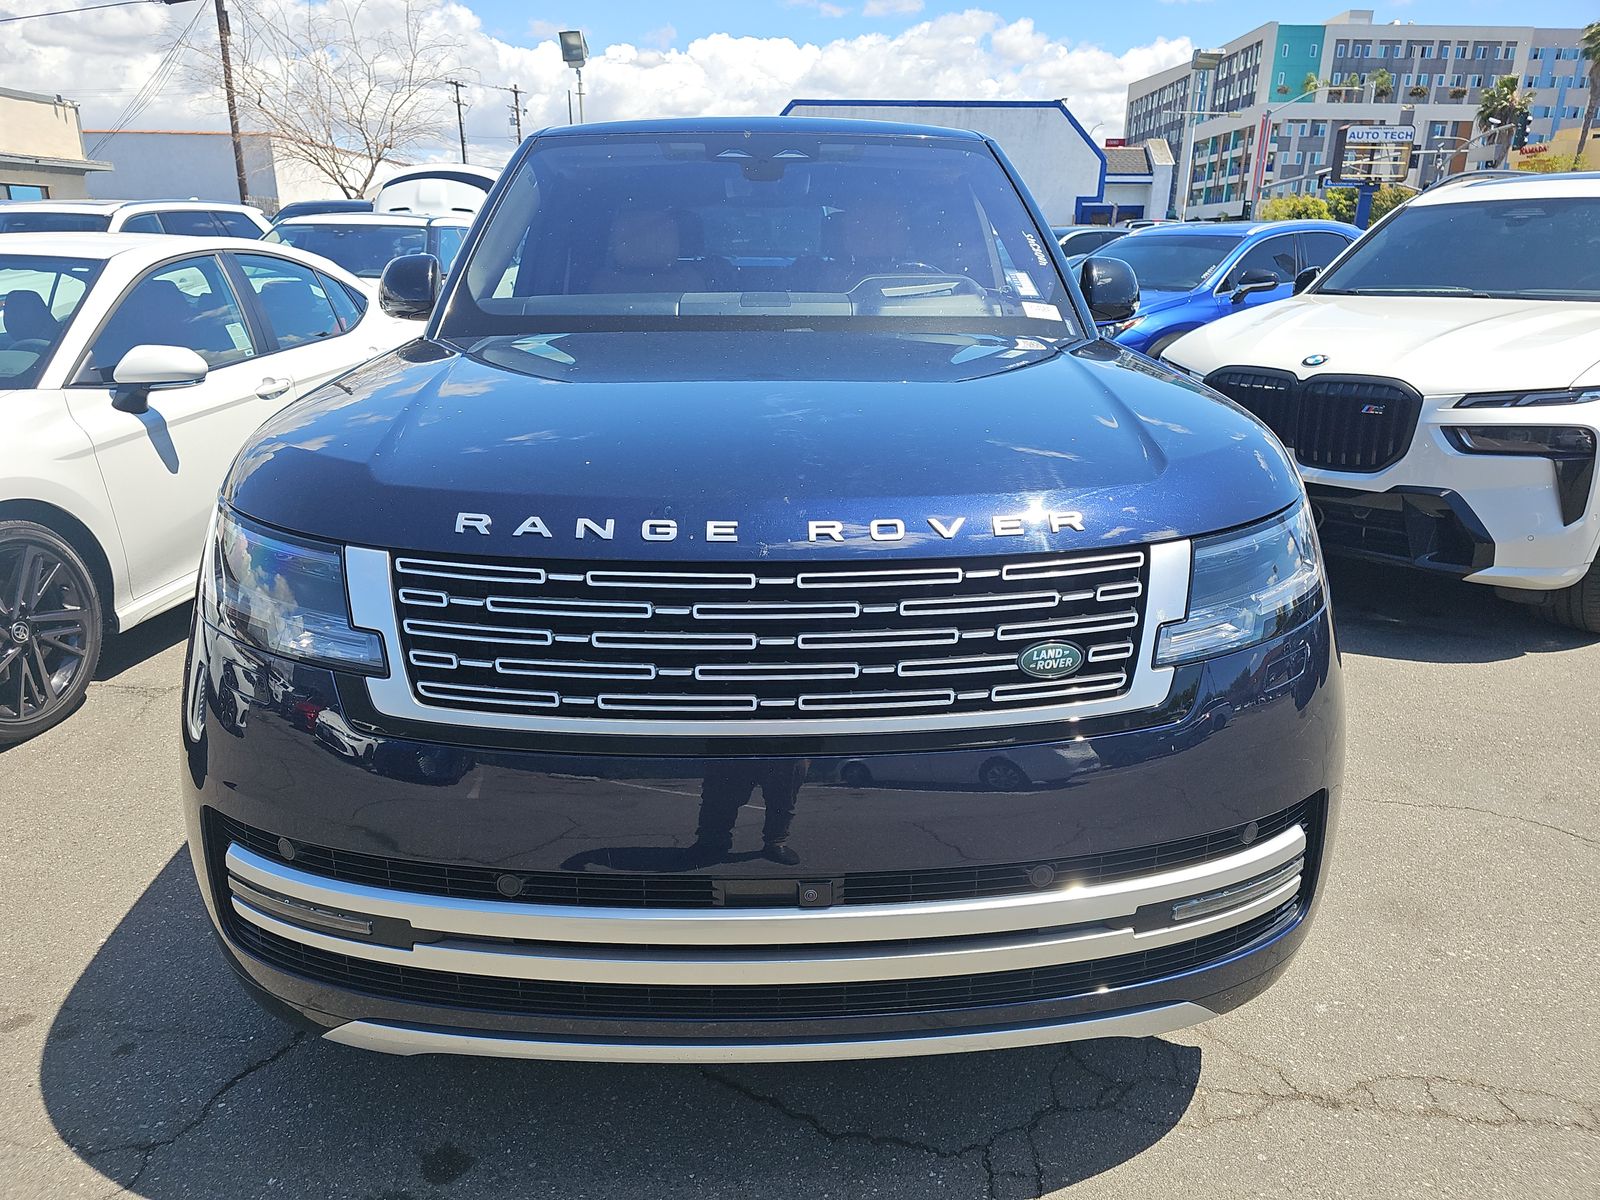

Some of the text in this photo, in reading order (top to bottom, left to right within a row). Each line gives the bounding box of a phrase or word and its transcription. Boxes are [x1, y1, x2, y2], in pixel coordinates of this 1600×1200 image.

[1348, 131, 1413, 140] AUTO TECH
[454, 511, 1085, 542] RANGE ROVER
